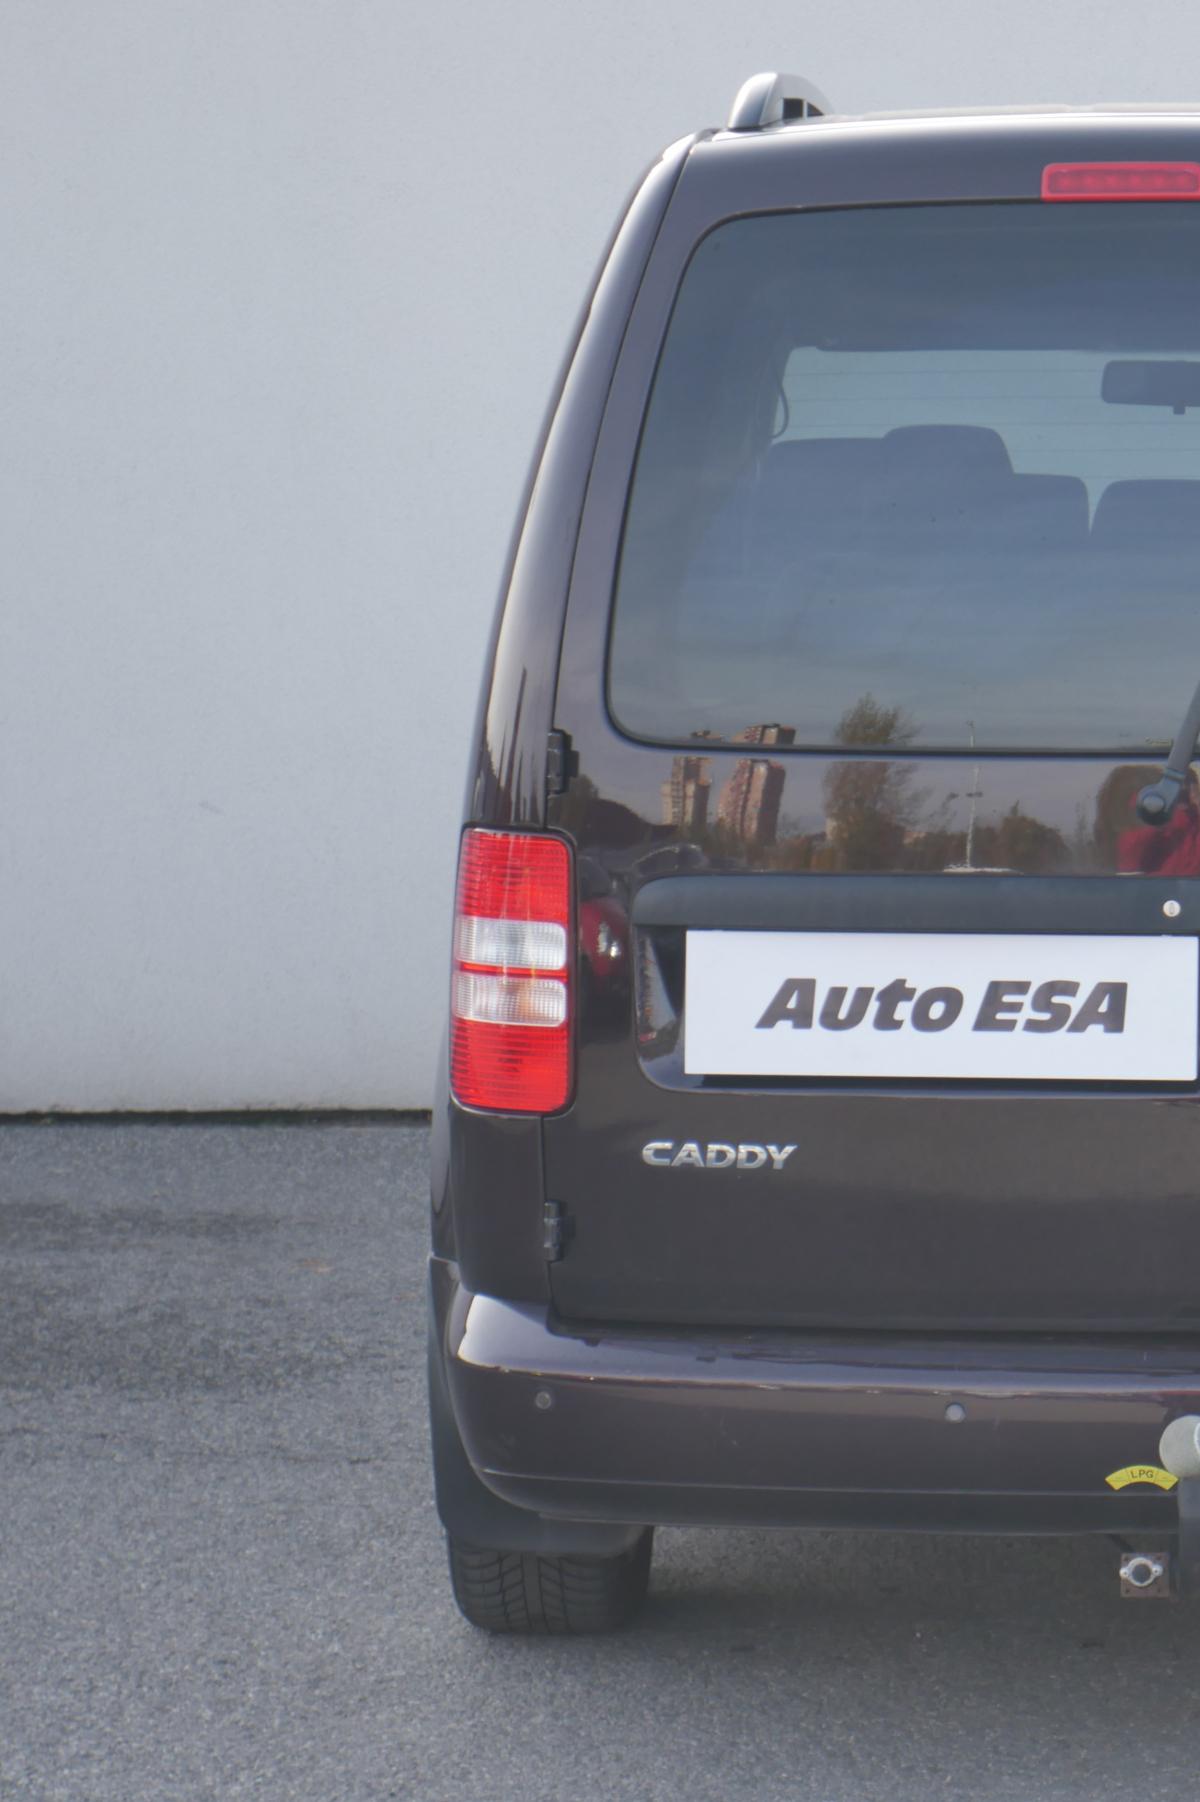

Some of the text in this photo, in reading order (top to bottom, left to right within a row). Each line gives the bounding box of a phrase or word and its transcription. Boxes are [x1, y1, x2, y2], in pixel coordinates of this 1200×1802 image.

[754, 977, 1129, 1034] Auto ESA
[641, 1141, 798, 1170] CADDY
[1129, 1469, 1154, 1479] LPG
